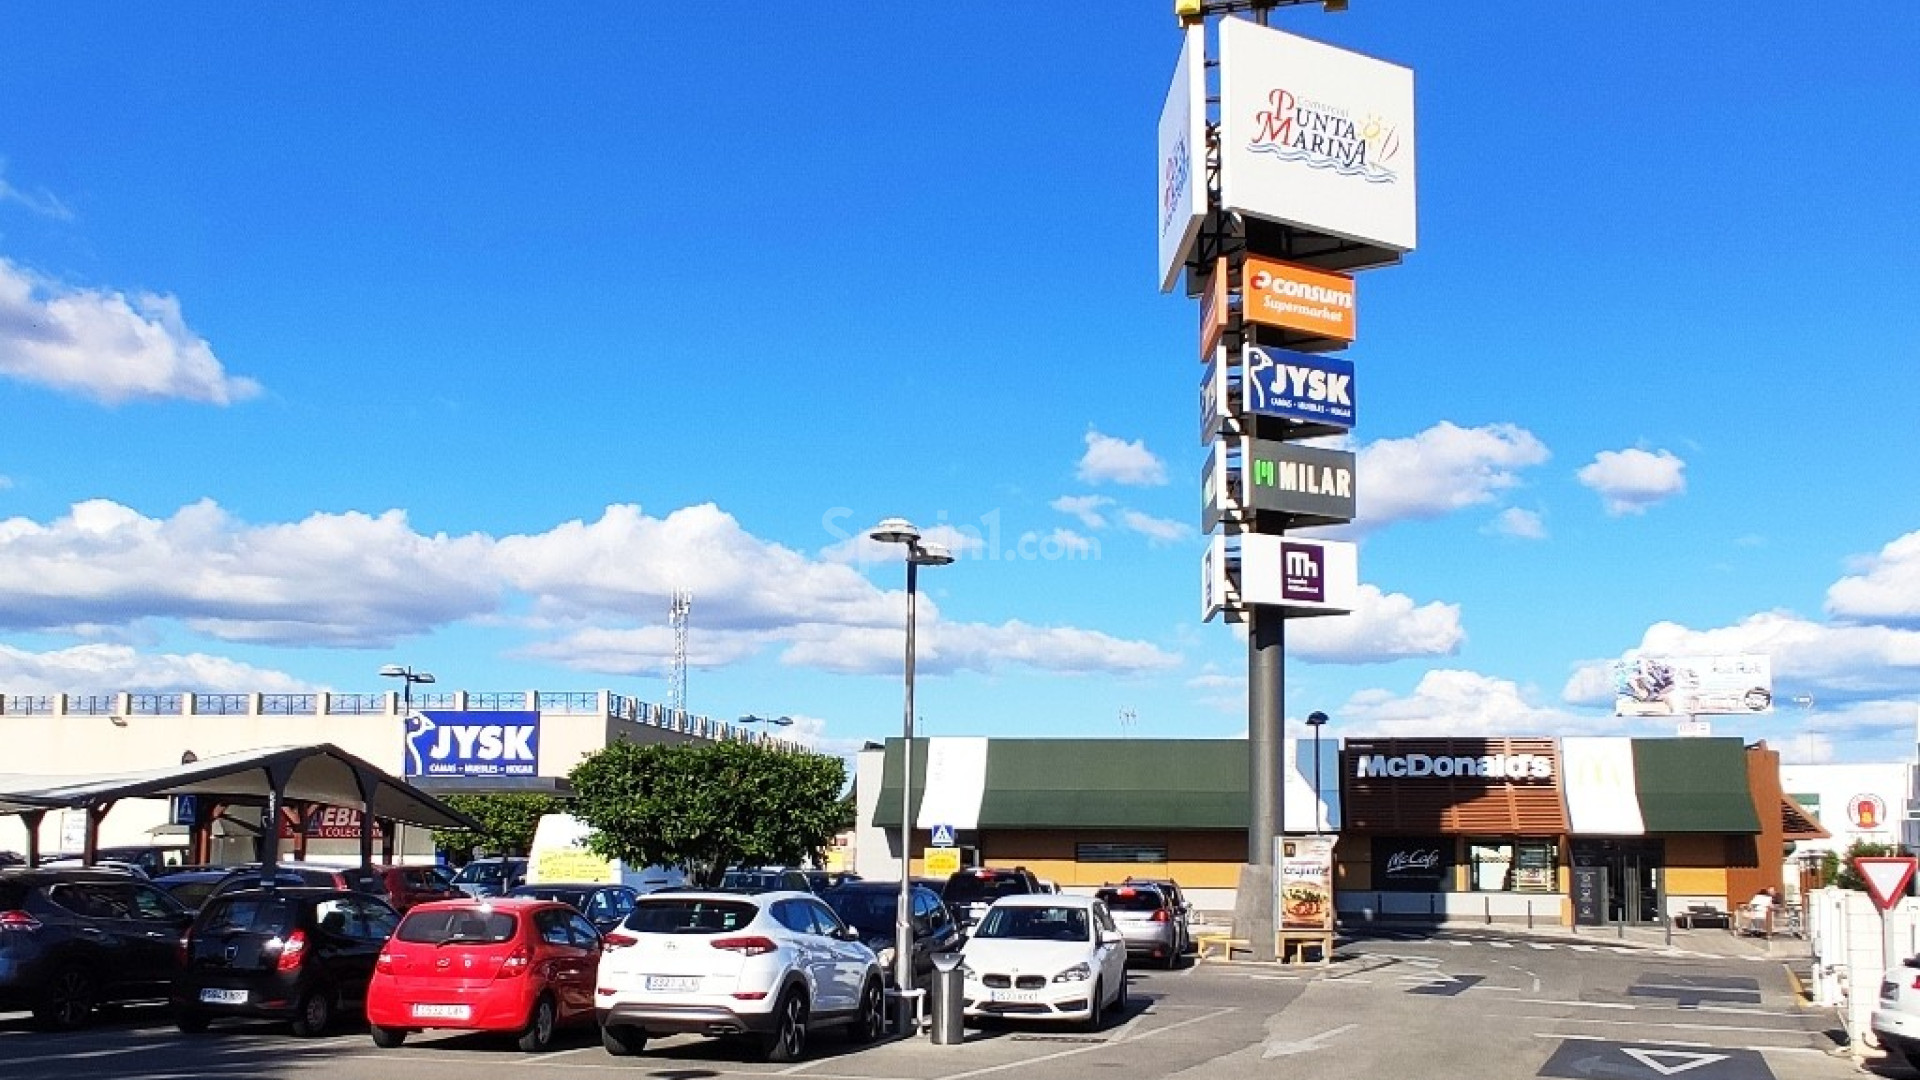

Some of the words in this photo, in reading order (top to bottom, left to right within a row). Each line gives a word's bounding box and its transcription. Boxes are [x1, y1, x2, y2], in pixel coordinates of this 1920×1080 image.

[1263, 294, 1344, 323] Supermarket
[1272, 277, 1352, 309] consum
[1270, 363, 1351, 407] JYSK
[1278, 460, 1351, 498] MILAR
[429, 725, 535, 760] JYSK
[1356, 753, 1551, 779] McDonald's
